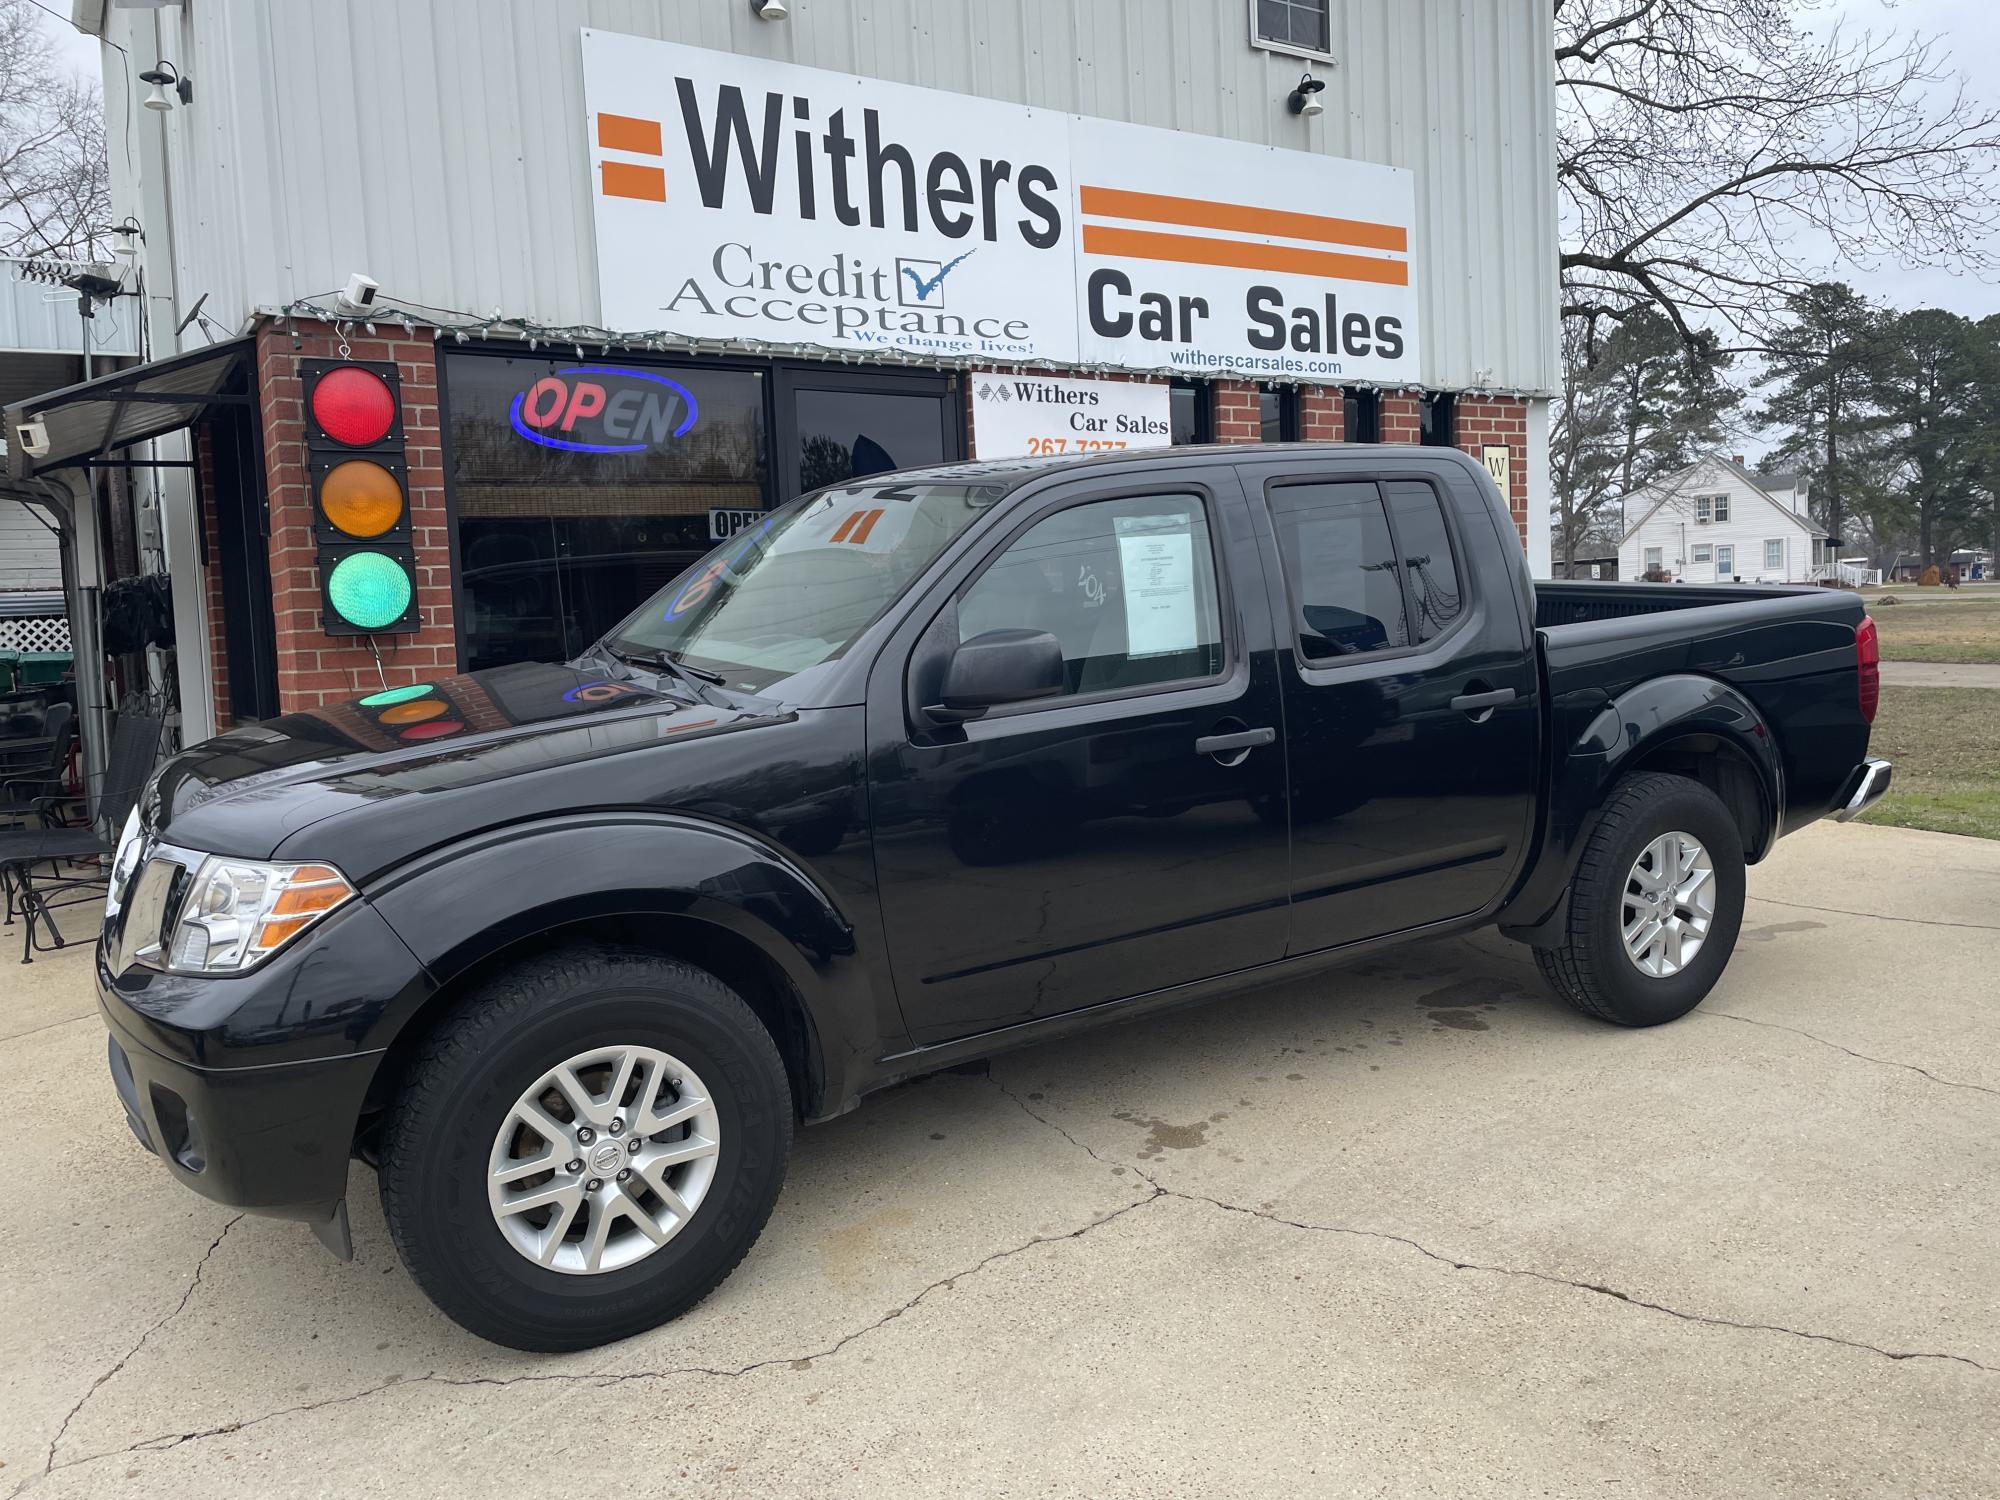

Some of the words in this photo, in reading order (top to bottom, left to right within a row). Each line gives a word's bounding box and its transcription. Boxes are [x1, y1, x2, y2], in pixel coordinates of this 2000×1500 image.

[674, 76, 1061, 250] Withers
[711, 242, 890, 302] Credit
[659, 277, 1030, 340] Acceptance
[1087, 268, 1209, 343] Car
[1246, 285, 1404, 359] Sales
[853, 330, 888, 343] We
[895, 334, 972, 352] change
[981, 339, 1034, 354] lives!
[1170, 349, 1343, 375] witherscarsales.com
[523, 377, 680, 444] OPEN
[1013, 382, 1099, 406] Withers
[1069, 411, 1108, 432] Car
[1116, 414, 1169, 435] Sales
